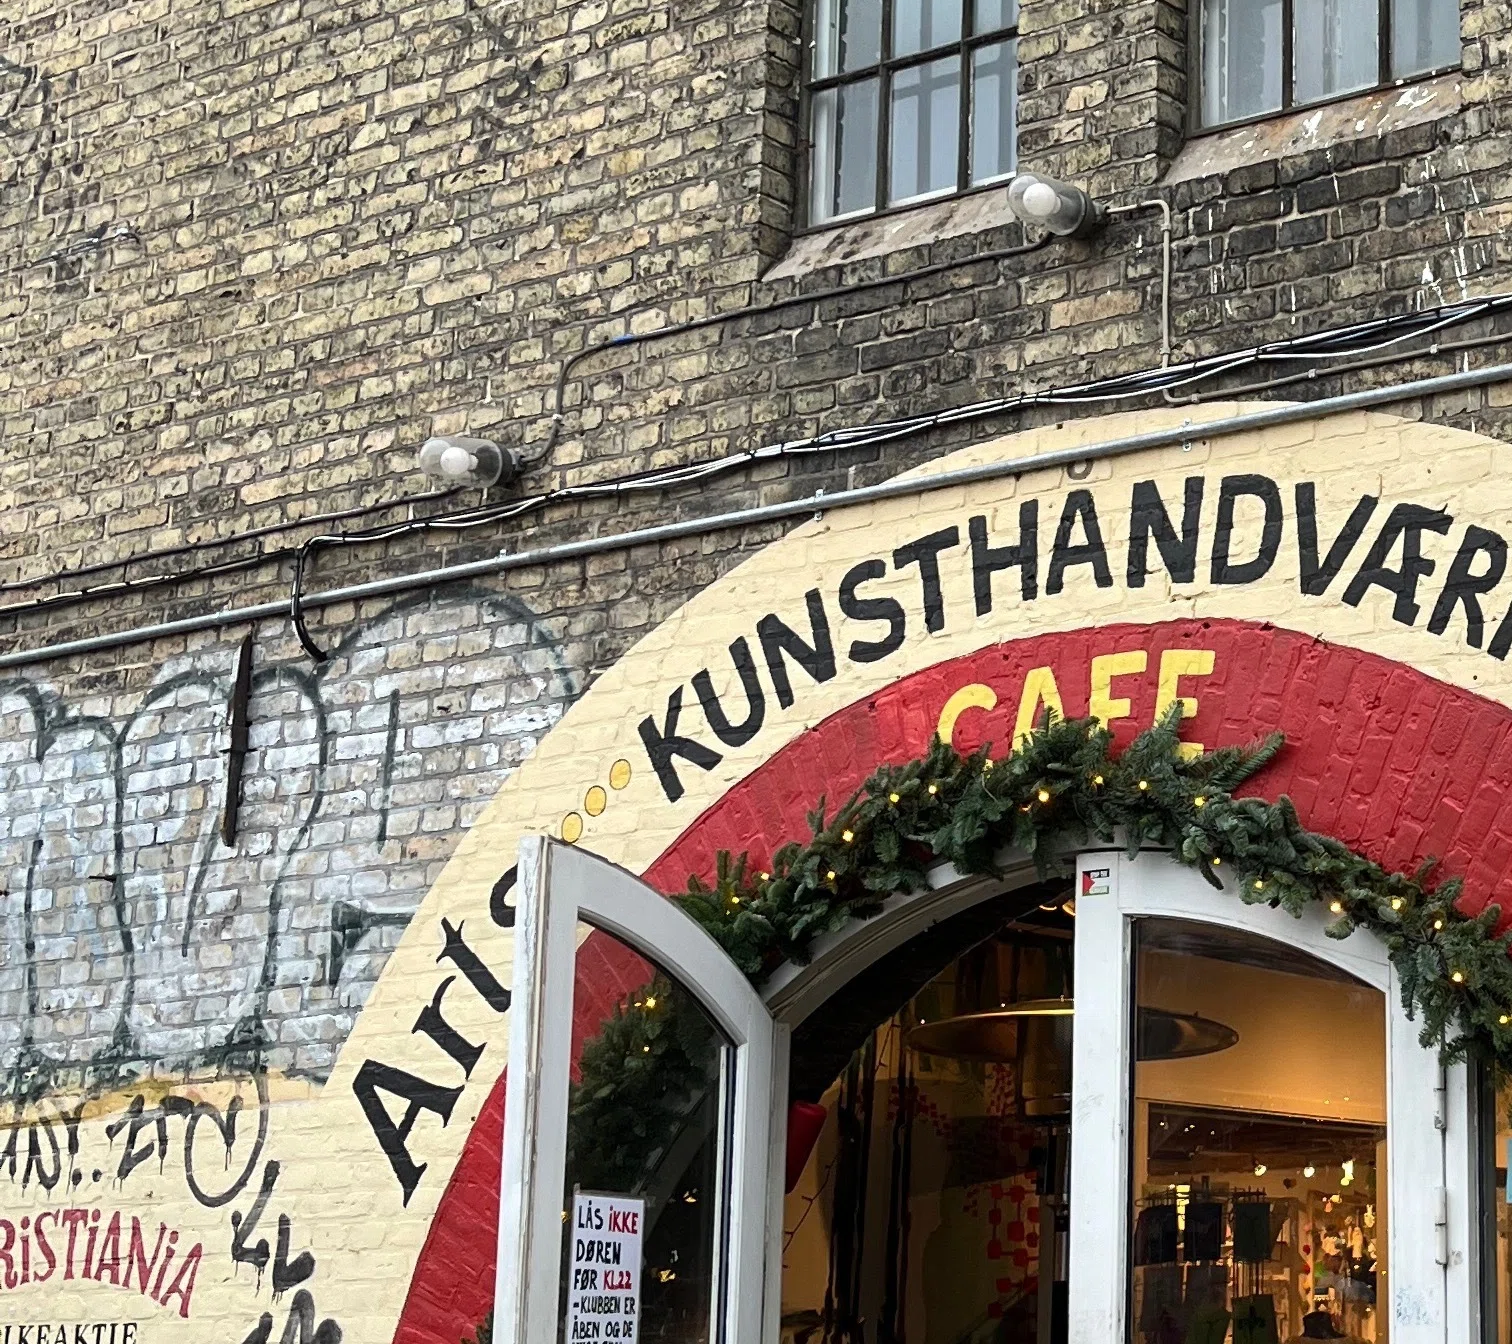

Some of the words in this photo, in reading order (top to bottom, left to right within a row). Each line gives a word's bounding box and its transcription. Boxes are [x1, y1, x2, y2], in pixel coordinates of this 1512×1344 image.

[937, 649, 1216, 762] CAFE
[351, 864, 520, 1208] Art
[578, 1201, 603, 1230] LÅS
[576, 1239, 621, 1265] DØREN
[574, 1269, 598, 1290] FØR
[624, 1296, 636, 1315] ER
[572, 1315, 600, 1340] ÅBEN
[605, 1321, 620, 1338] OG
[622, 1320, 633, 1339] DE
